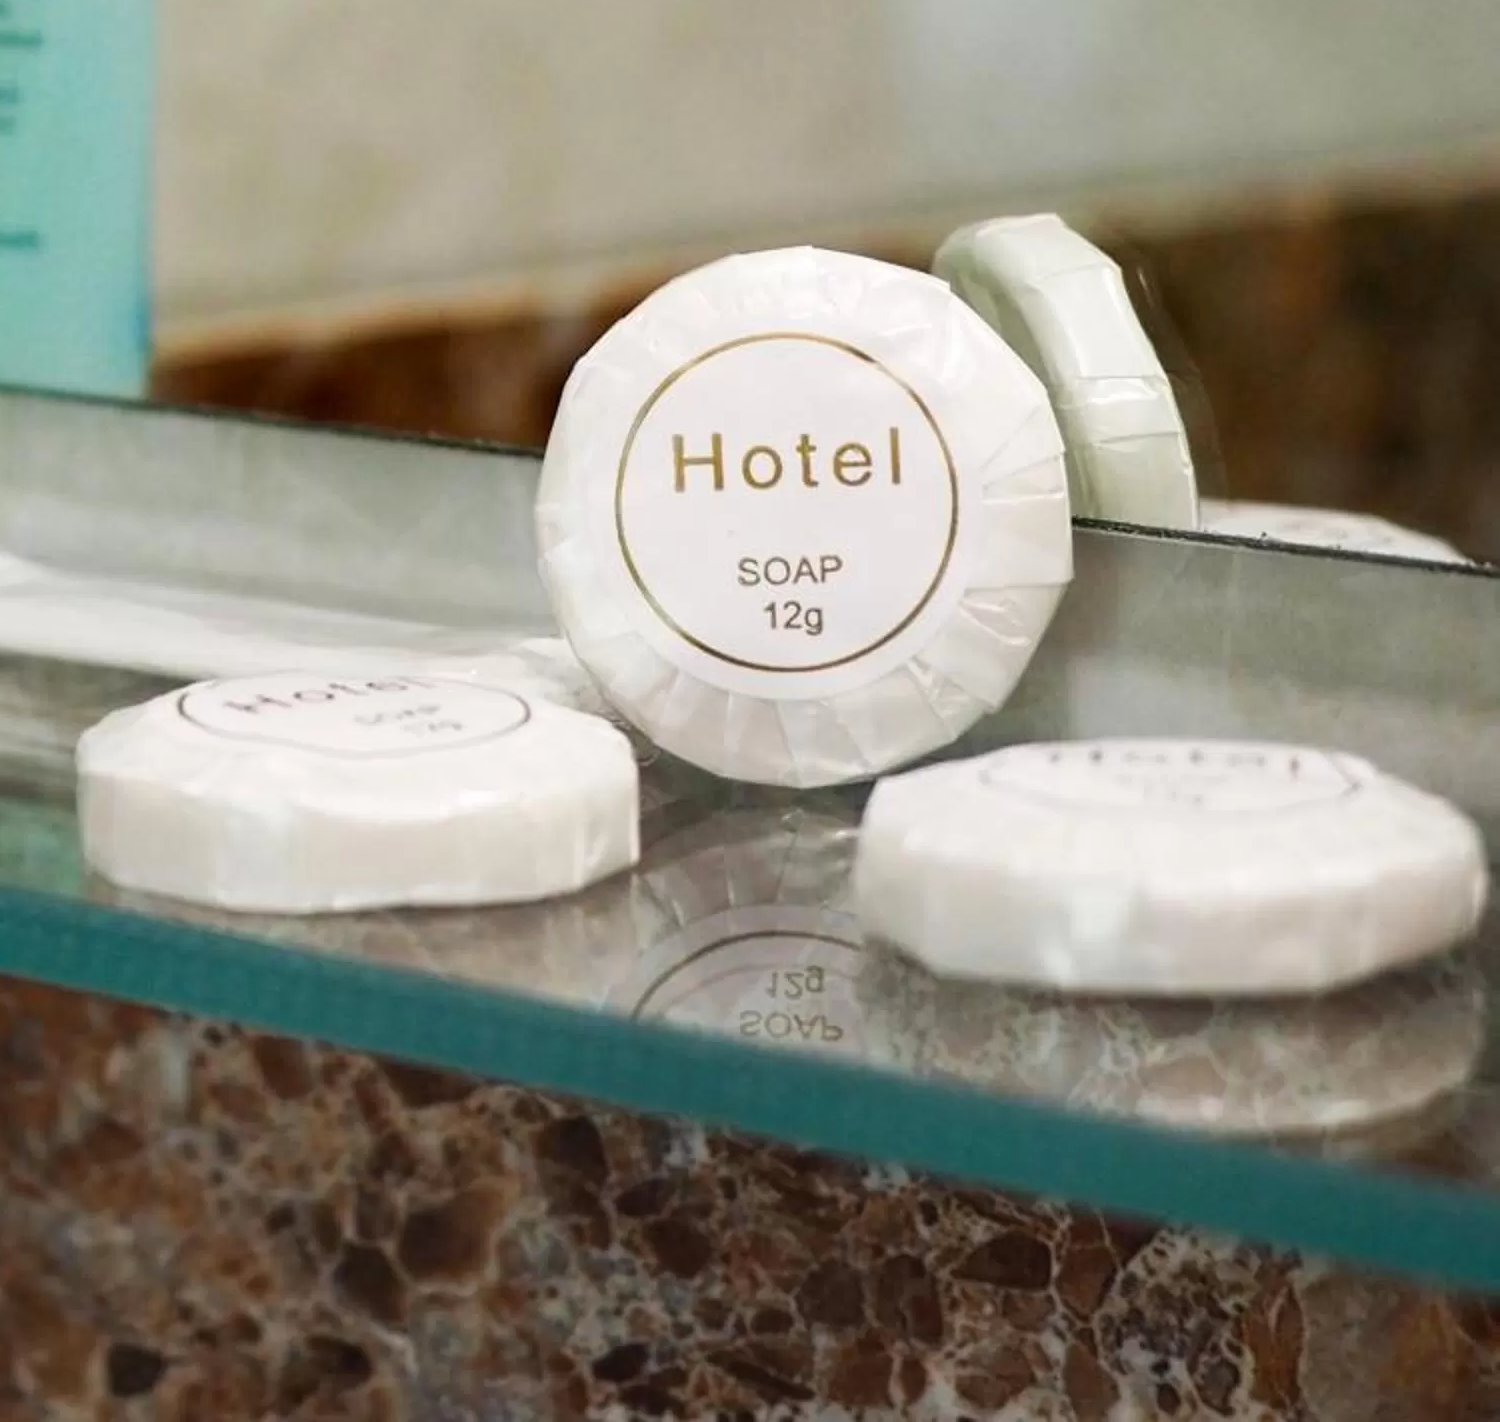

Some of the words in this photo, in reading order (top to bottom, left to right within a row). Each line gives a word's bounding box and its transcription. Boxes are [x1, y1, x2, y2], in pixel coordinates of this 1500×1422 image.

[672, 426, 903, 492] Hotel
[736, 554, 844, 586] SOAP
[763, 600, 825, 636] 12g
